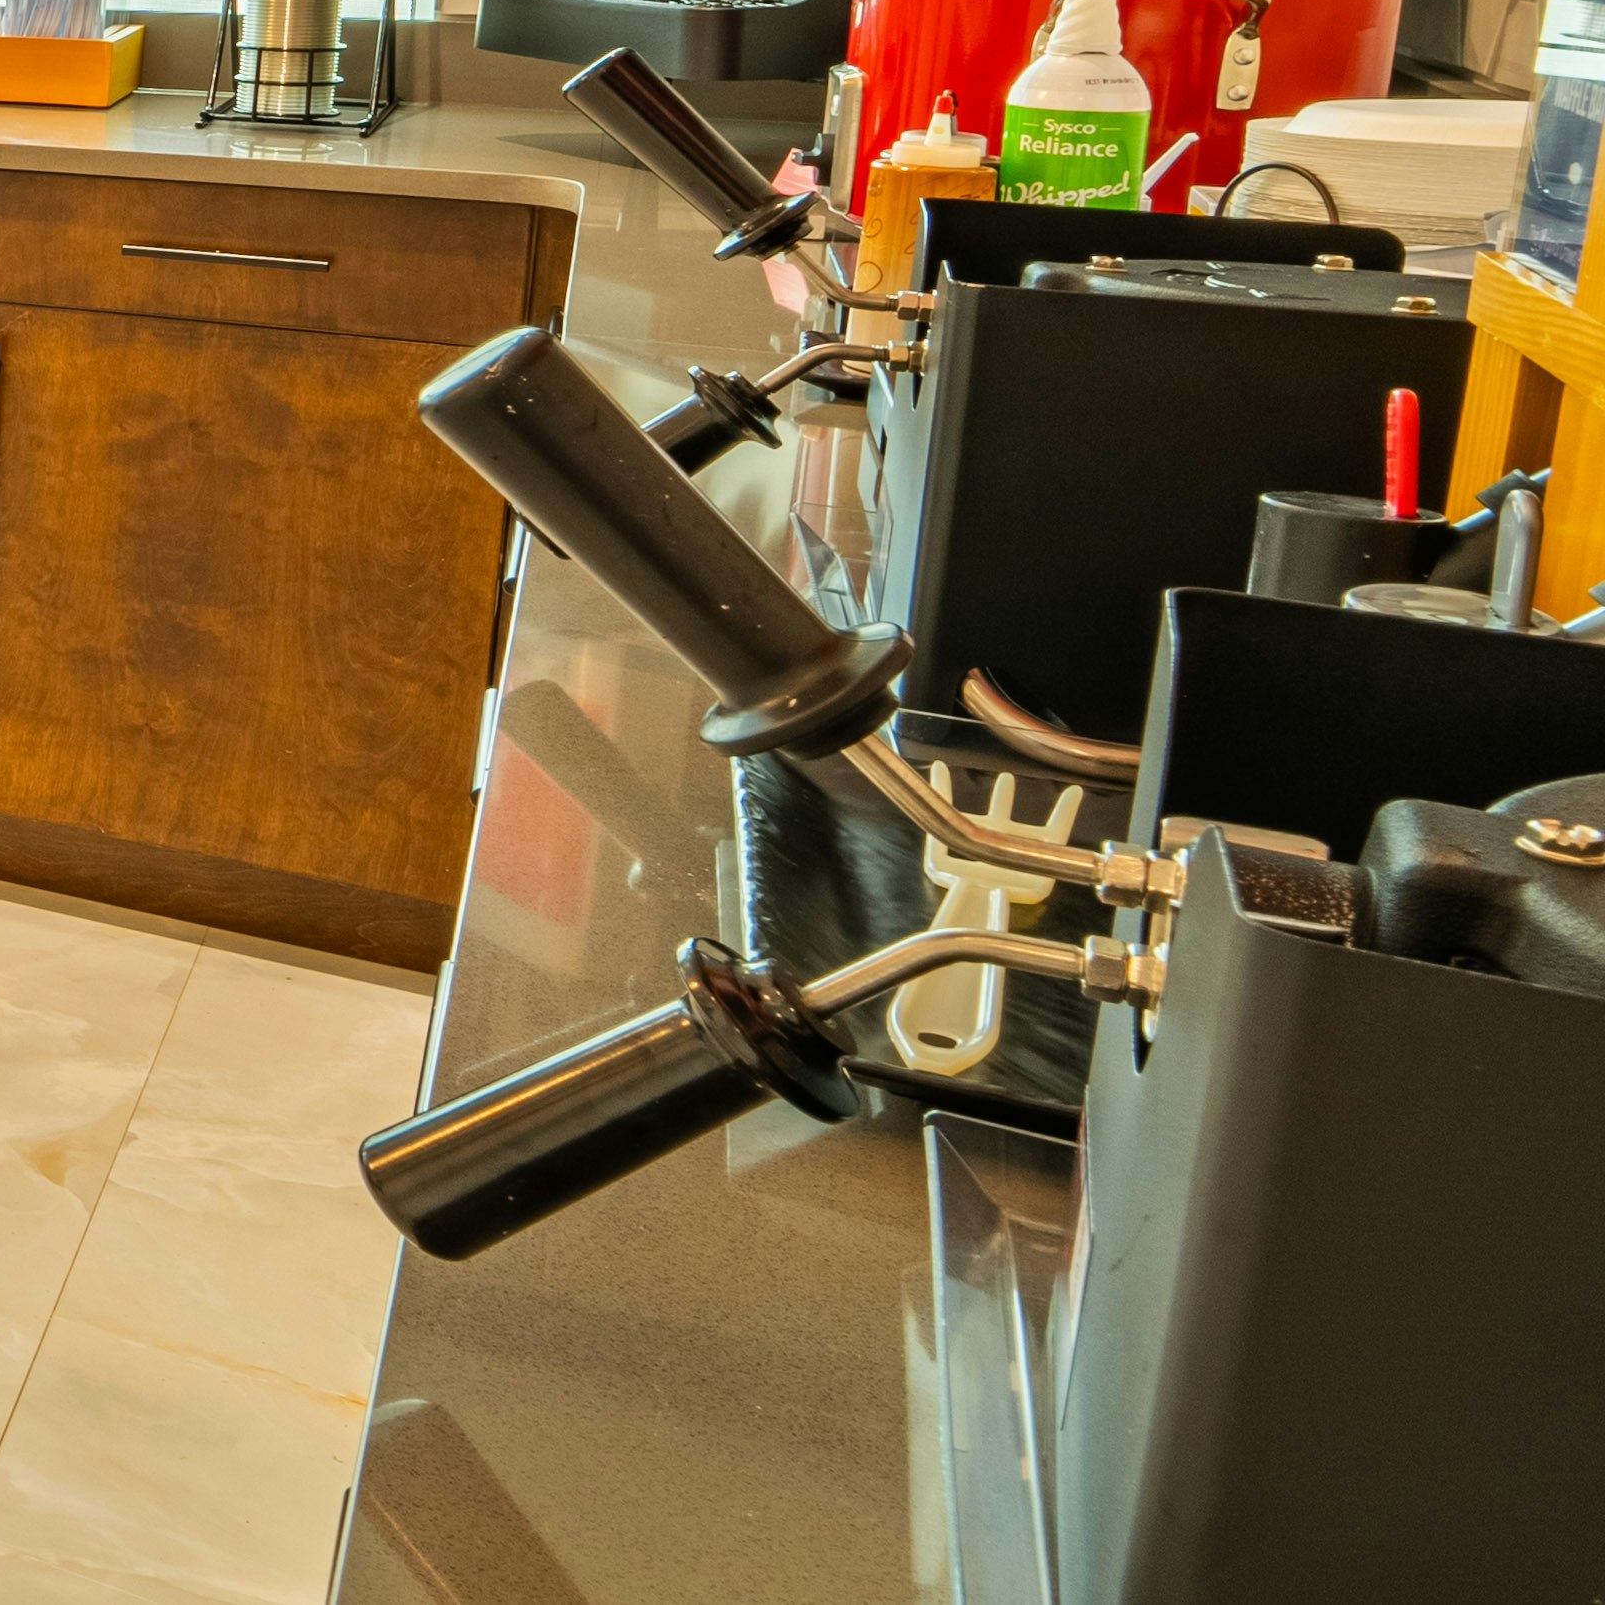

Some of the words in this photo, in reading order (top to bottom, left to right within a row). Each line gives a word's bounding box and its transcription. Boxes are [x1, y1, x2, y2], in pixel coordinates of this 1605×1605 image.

[1043, 118, 1096, 135] Sysco
[1019, 134, 1119, 157] Reliance
[1001, 170, 1130, 207] Whipped
